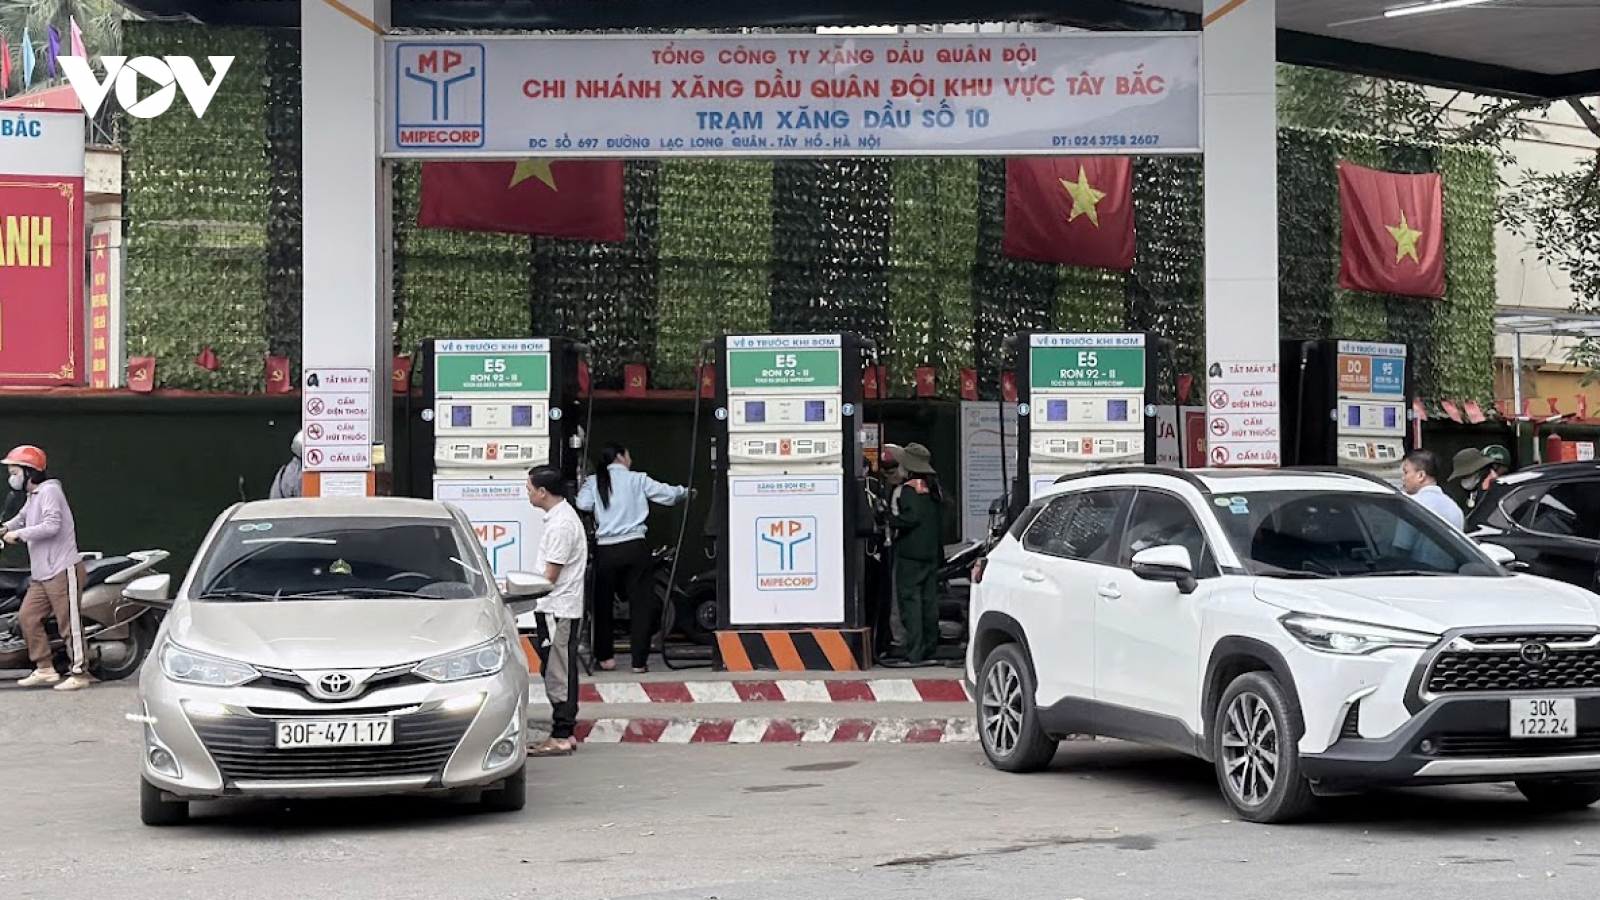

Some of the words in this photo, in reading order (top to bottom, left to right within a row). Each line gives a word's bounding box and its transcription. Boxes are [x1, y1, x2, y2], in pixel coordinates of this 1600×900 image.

[652, 42, 705, 64] TỔNG
[718, 45, 777, 64] CÔNG
[788, 50, 809, 64] TY
[818, 45, 874, 64] XĂNG
[887, 40, 924, 63] DẦU
[937, 44, 991, 63] QUÂN
[1002, 43, 1036, 66] ĐỘI
[522, 80, 565, 98] CHI
[576, 74, 661, 98] NHÁNH
[671, 75, 744, 98] XĂNG
[755, 69, 801, 98] DẦU
[811, 74, 880, 98] QUÂN
[891, 73, 934, 102] ĐỘI
[944, 78, 992, 97] KHU
[1004, 75, 1055, 101] VỰC
[1066, 70, 1106, 95] TÂY
[1116, 63, 1165, 95] BẮC
[695, 111, 763, 134] TRẠM
[776, 105, 849, 129] XĂNG
[864, 100, 911, 128] DẦU
[922, 98, 955, 128] SỐ
[966, 108, 990, 128] 10
[1, 113, 41, 137] BẮC
[401, 131, 480, 143] MIPECORP
[529, 138, 547, 148] ĐC
[555, 132, 572, 148] SỐ
[578, 138, 599, 148] 697
[606, 134, 650, 148] ĐƯỜNG
[660, 138, 684, 151] LẠC
[690, 138, 724, 148] LONG
[858, 134, 881, 149] NỘI
[1130, 135, 1159, 145] 2607
[0, 216, 52, 267] NH
[484, 358, 507, 373] E5
[775, 354, 797, 368] E5
[1077, 351, 1098, 367] E5
[762, 369, 782, 377] RON
[1246, 364, 1264, 373] MÁY
[1347, 360, 1361, 374] DO
[1382, 362, 1393, 375] 95
[1060, 369, 1084, 379] RON
[1086, 369, 1099, 378] 92
[1243, 387, 1263, 397] CẤM
[337, 397, 355, 405] CẤM
[1231, 399, 1250, 409] ĐIỆN
[1243, 417, 1263, 425] CẤM
[330, 454, 350, 462] CẤM
[1237, 450, 1259, 460] CẤM
[760, 577, 813, 587] MIPECORP
[1530, 700, 1557, 716] 30K
[281, 721, 388, 744] 30F-471.17
[1520, 718, 1568, 734] 122.24
